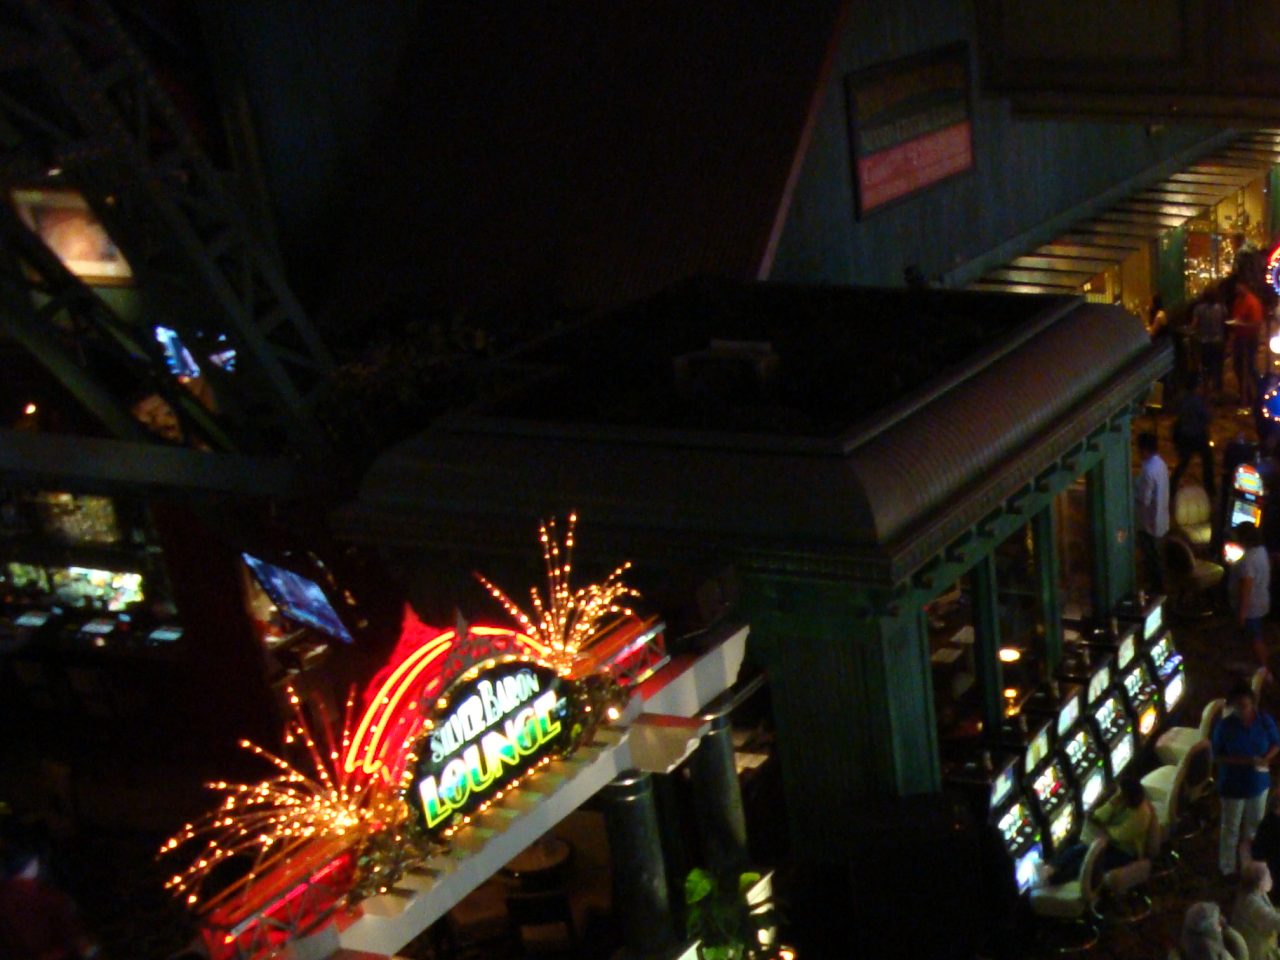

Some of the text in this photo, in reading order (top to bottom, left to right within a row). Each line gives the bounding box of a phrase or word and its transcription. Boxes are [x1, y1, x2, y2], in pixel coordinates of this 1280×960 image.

[419, 690, 561, 829] LOUNGE
[430, 669, 540, 763] SILVER BARON
